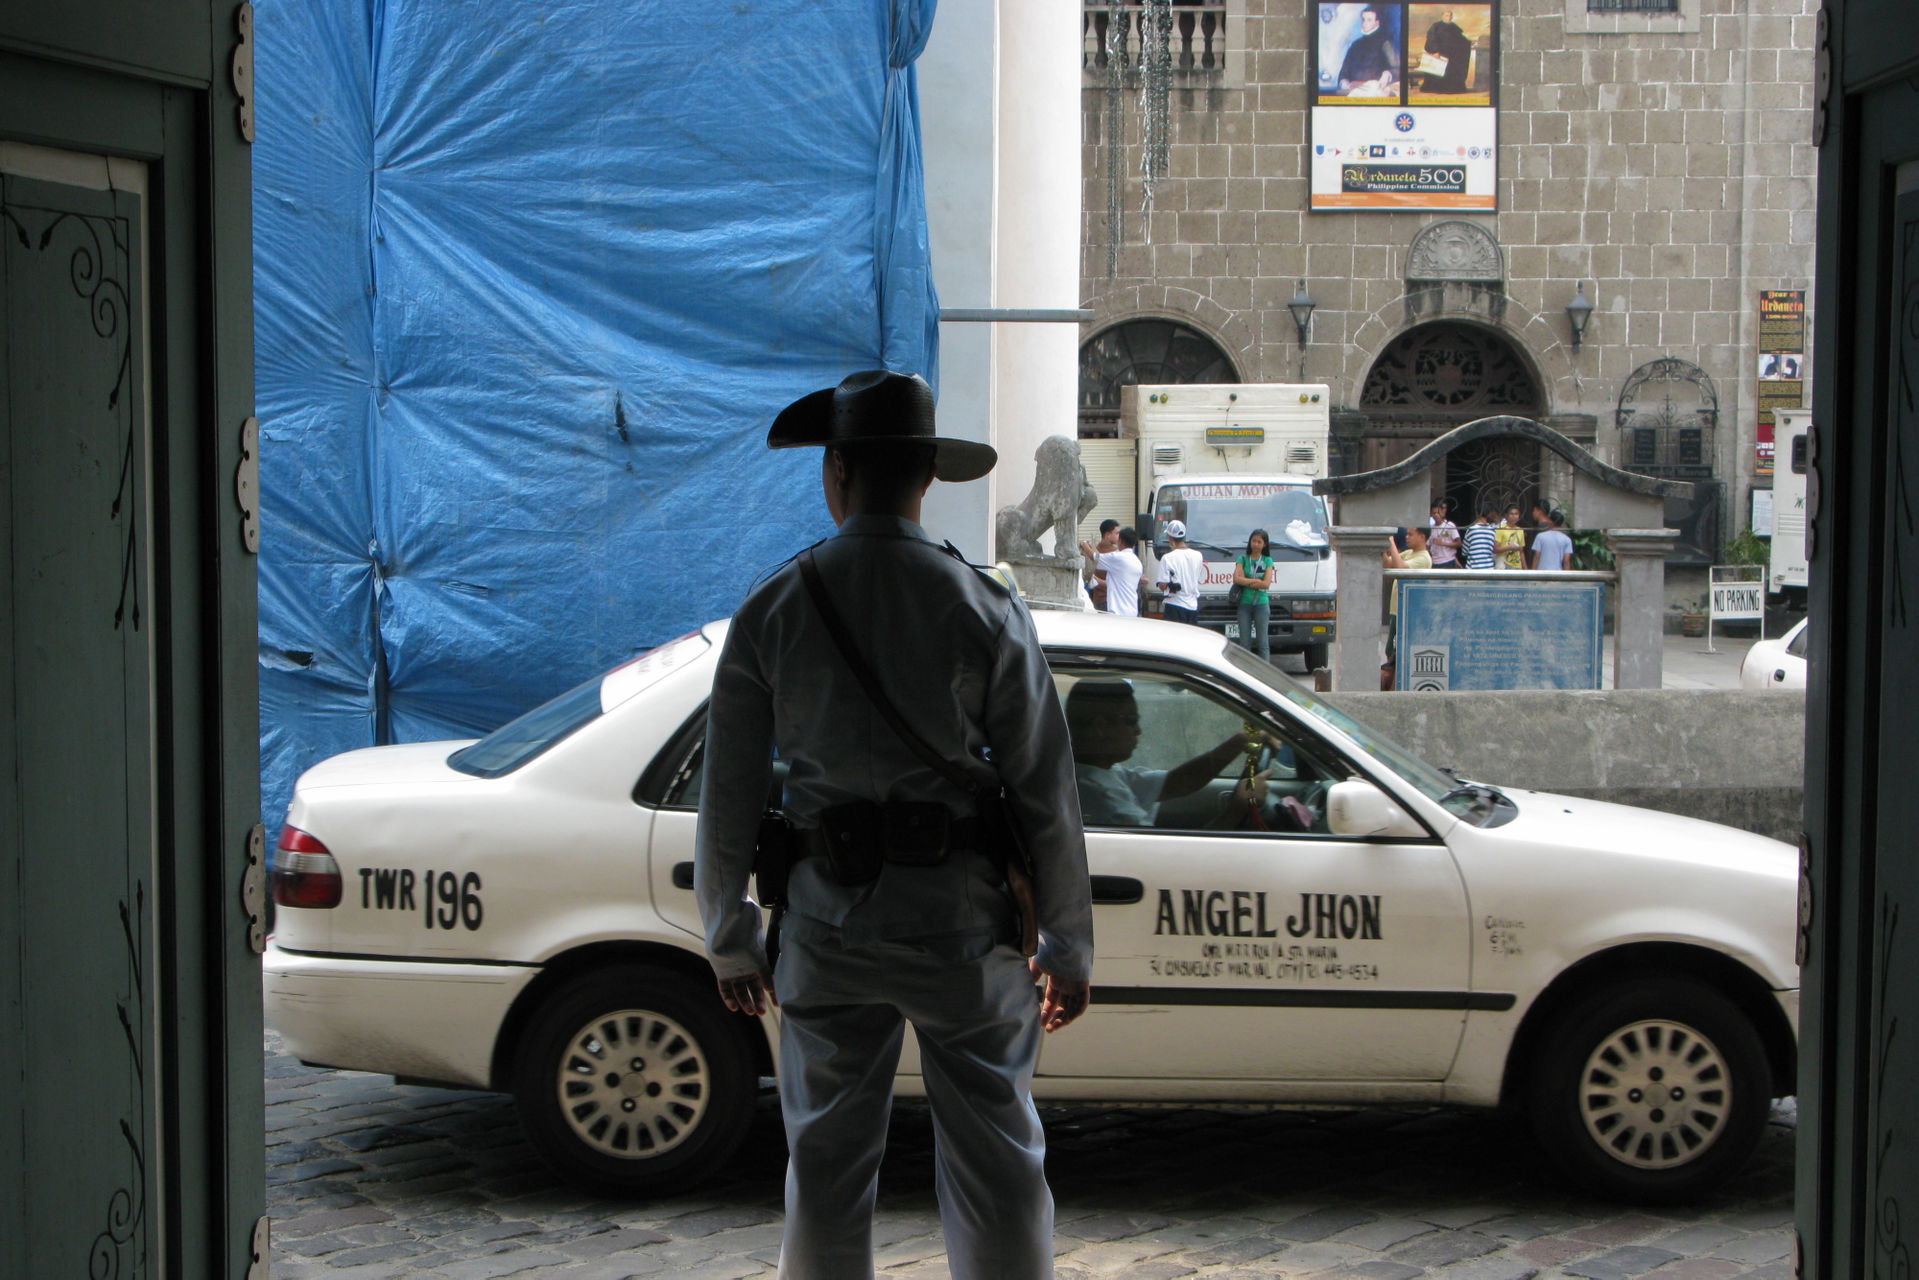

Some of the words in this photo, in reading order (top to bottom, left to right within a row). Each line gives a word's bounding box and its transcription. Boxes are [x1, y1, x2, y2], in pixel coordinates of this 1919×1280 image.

[1420, 168, 1464, 184] 500
[1183, 485, 1233, 498] JULIAN
[1198, 560, 1236, 585] Quee
[1714, 590, 1724, 612] NO
[1726, 589, 1760, 612] PARKING
[359, 867, 416, 911] TWR
[425, 869, 483, 931] 196
[1154, 888, 1277, 938] ANGEL
[1287, 892, 1383, 940] JHON
